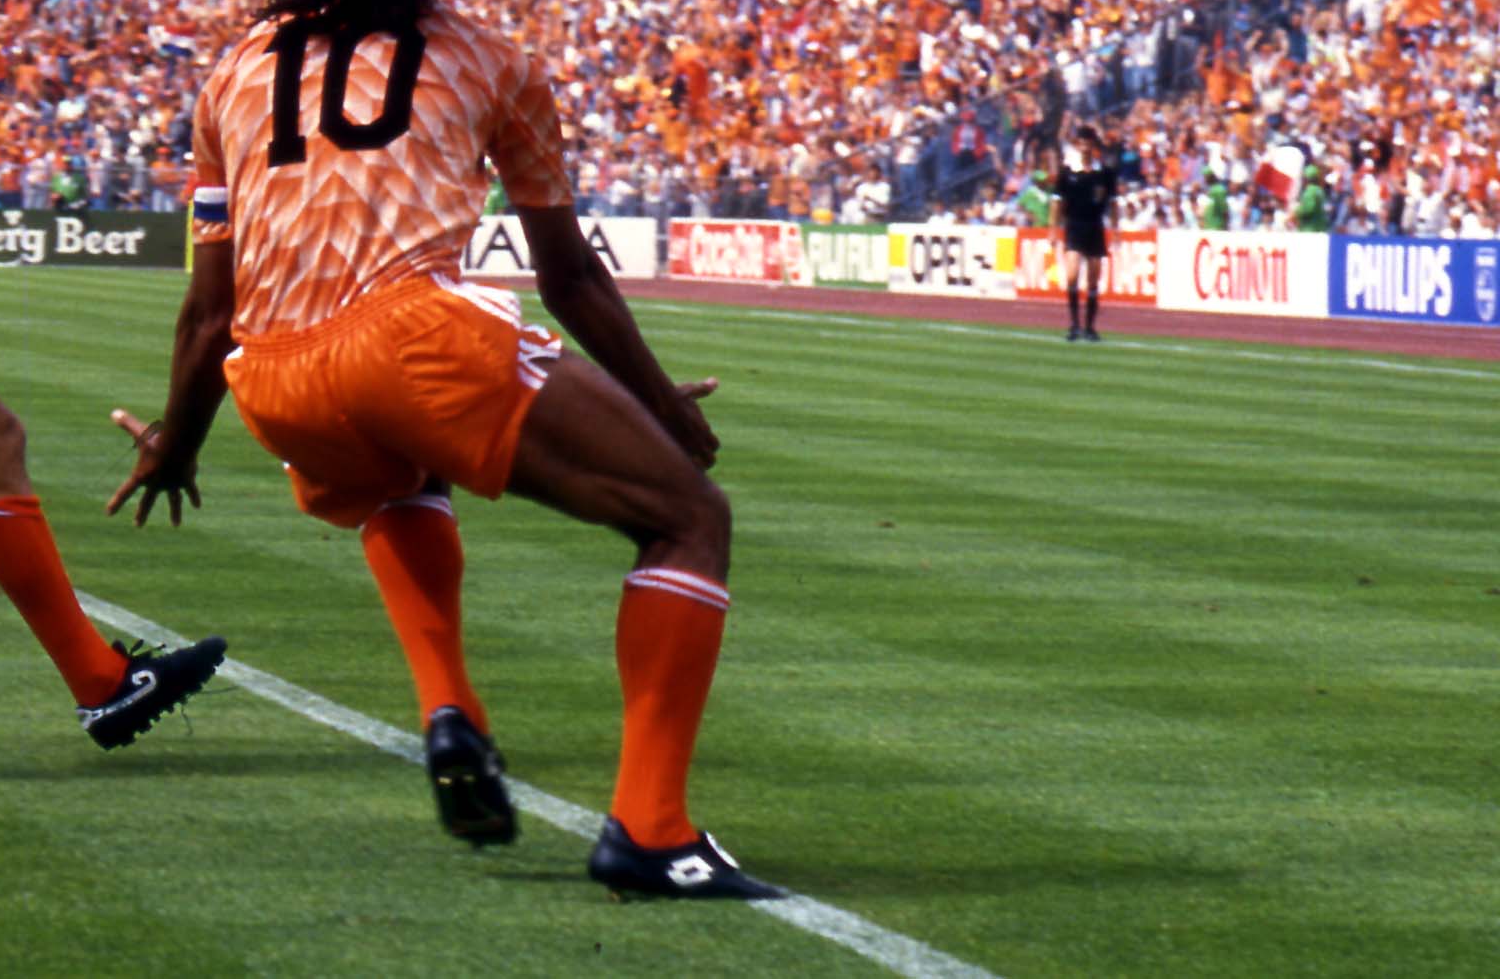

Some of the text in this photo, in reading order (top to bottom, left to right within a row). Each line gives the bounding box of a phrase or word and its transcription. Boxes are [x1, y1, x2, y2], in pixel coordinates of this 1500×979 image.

[56, 217, 146, 256] Beer
[910, 234, 972, 286] OPEL
[1193, 237, 1289, 303] Canon
[1346, 242, 1453, 317] PHILIPS
